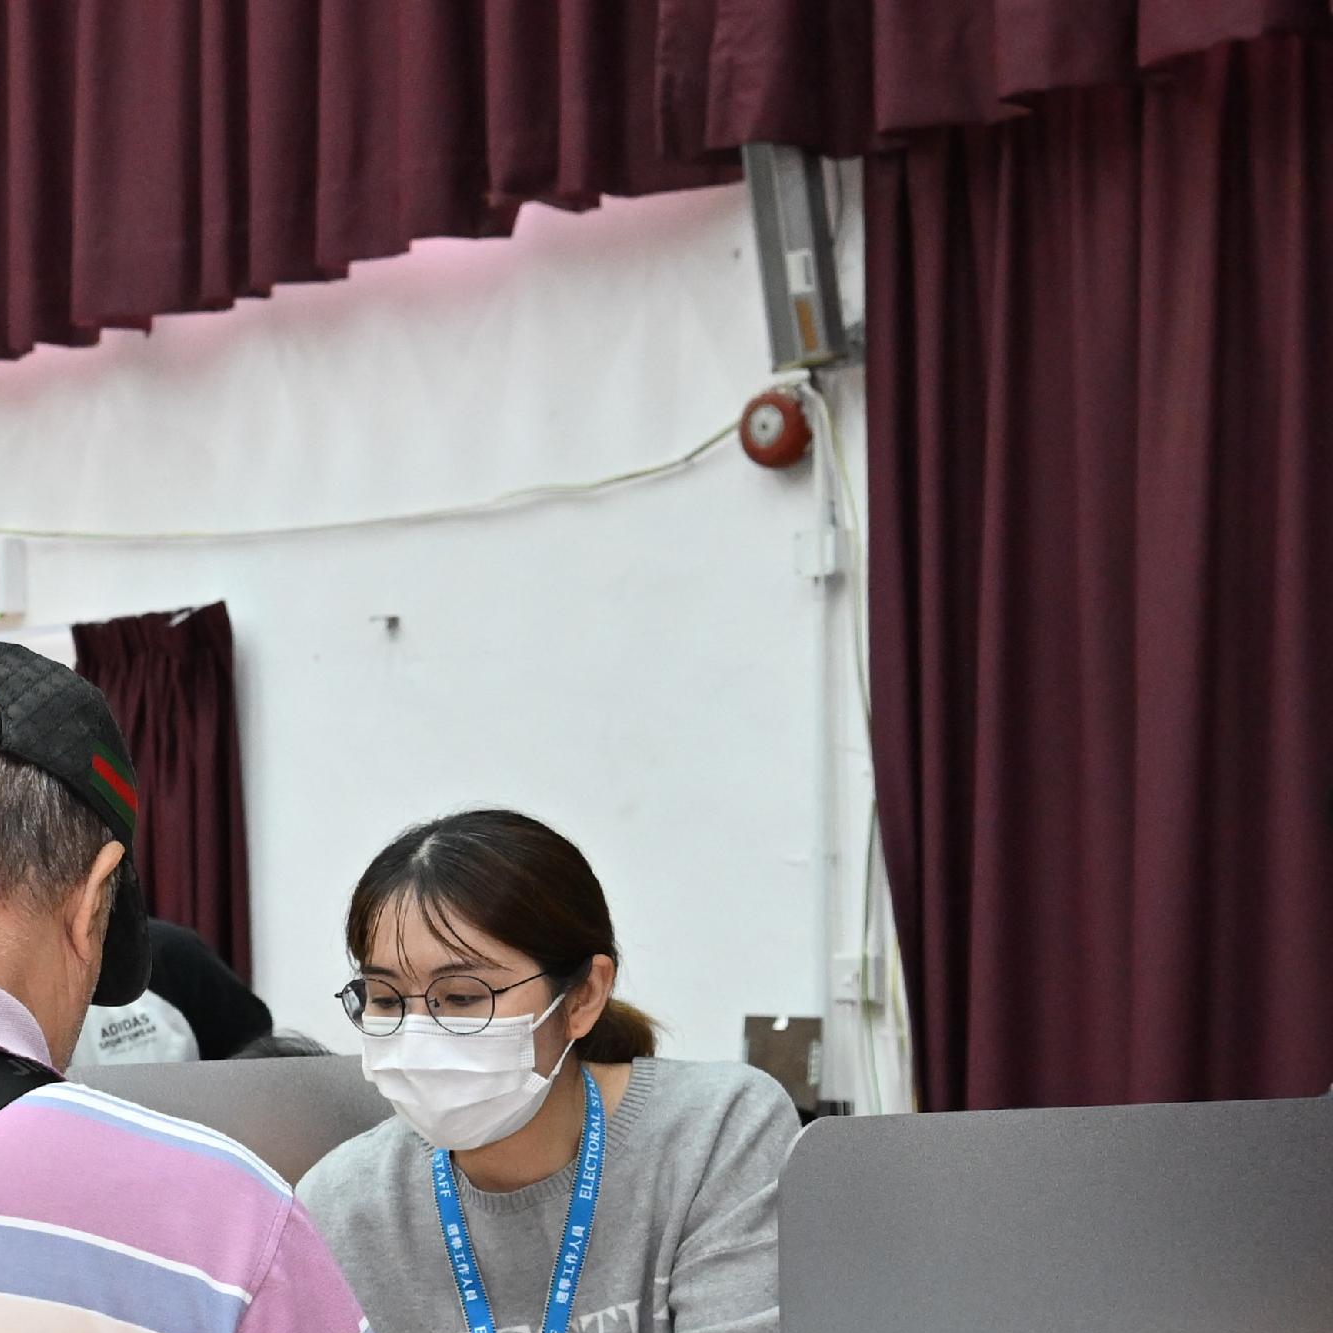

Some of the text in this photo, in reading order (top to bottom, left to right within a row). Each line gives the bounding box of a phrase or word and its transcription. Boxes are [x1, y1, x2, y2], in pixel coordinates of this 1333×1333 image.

[100, 1013, 150, 1038] ADIDAS
[434, 1152, 451, 1198] STAFF
[579, 1111, 601, 1201] ELECTORAL
